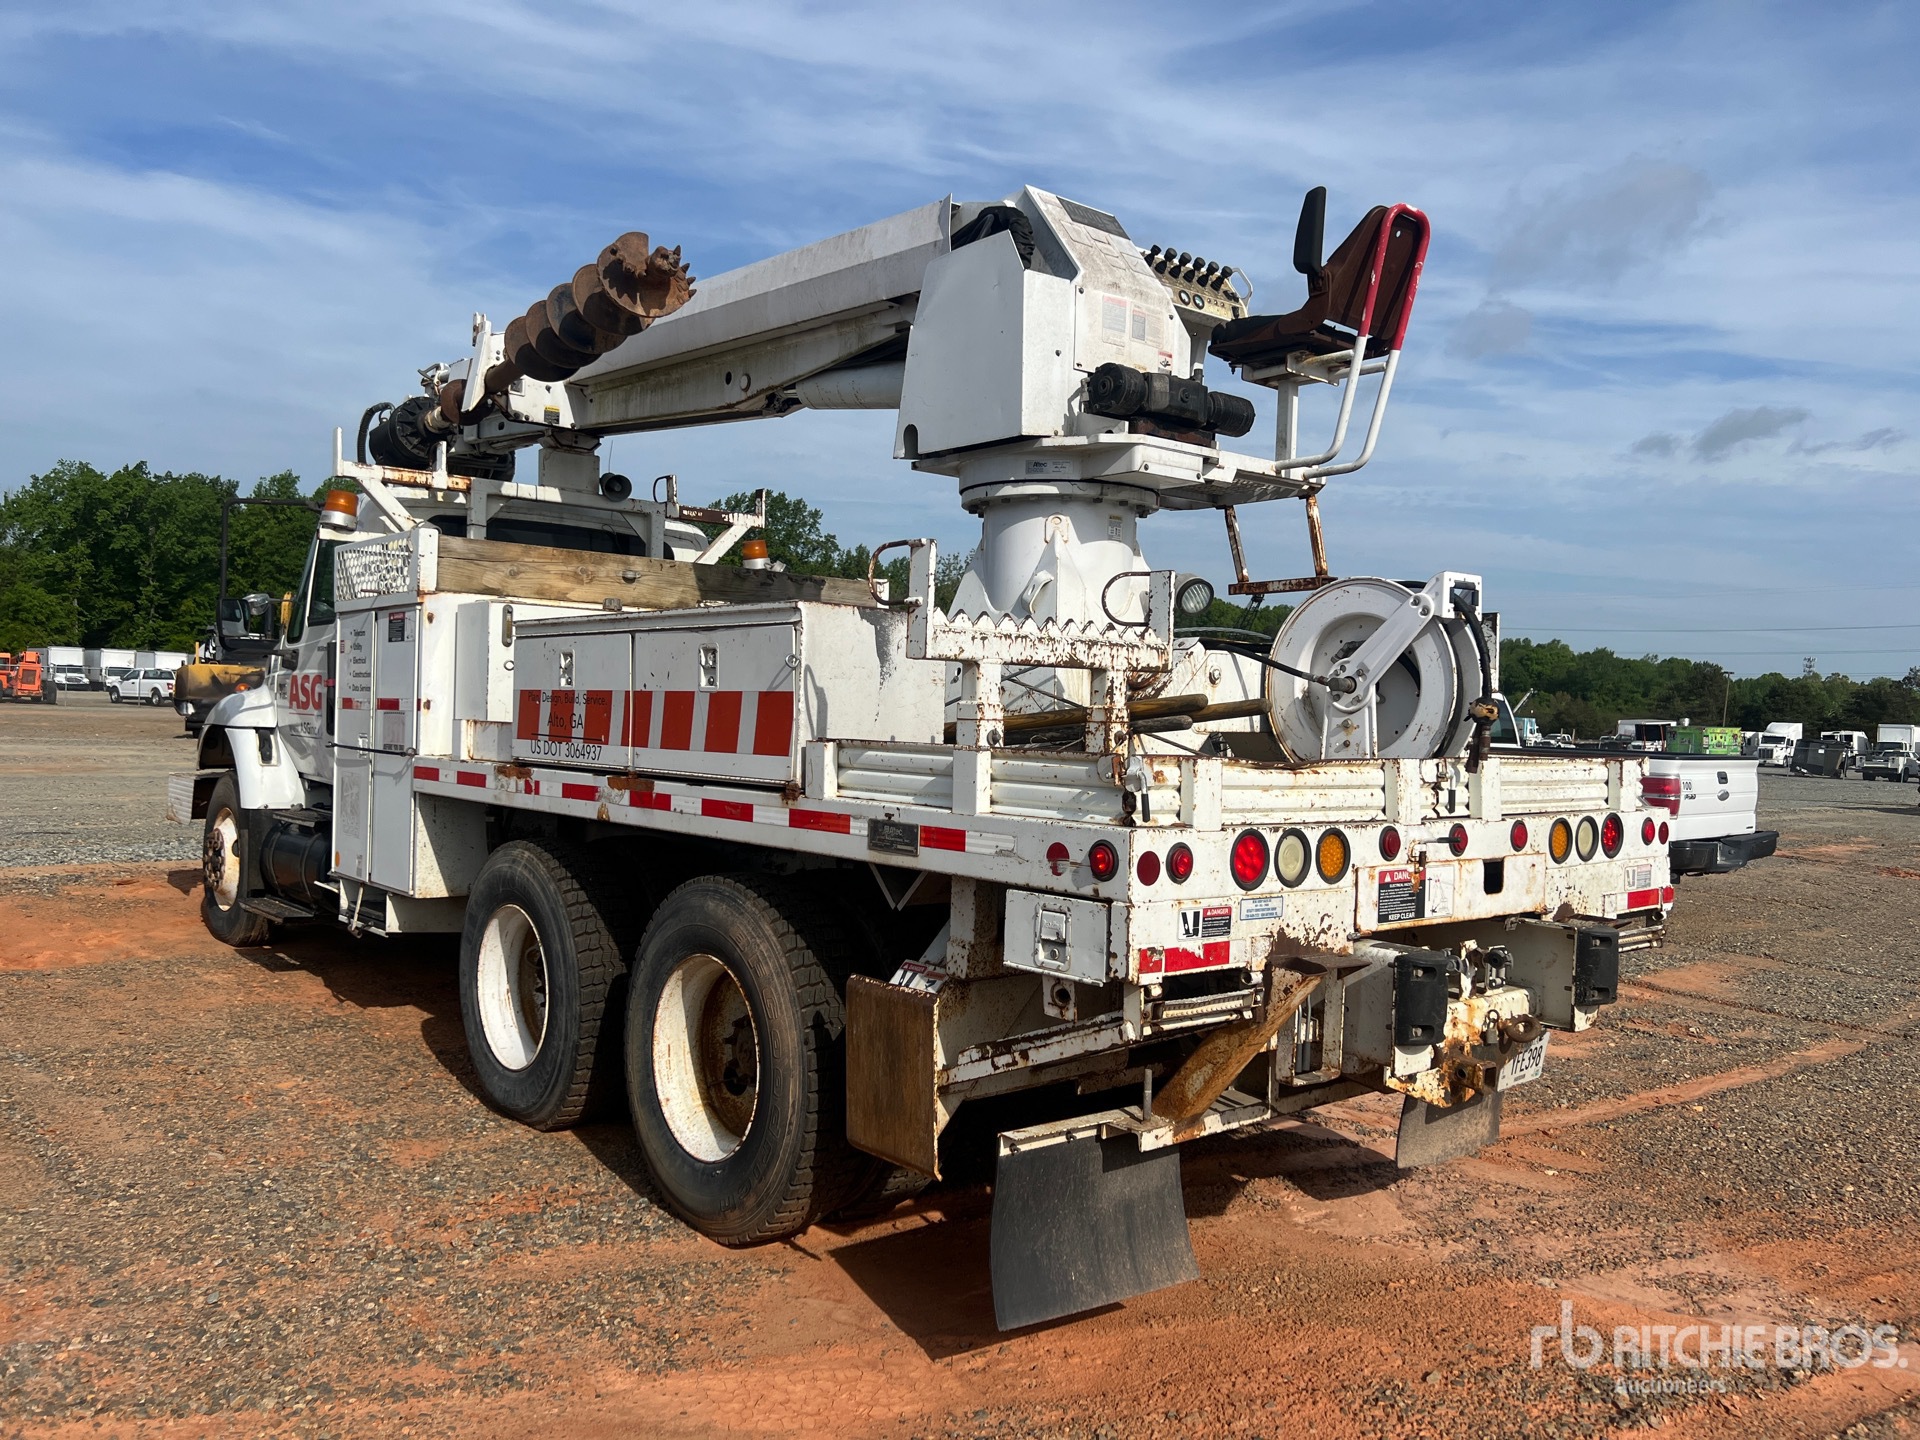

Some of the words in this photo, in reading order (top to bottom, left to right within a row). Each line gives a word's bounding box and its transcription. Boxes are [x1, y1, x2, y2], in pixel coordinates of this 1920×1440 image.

[288, 674, 323, 711] ASG
[547, 712, 567, 731] Alto,
[569, 712, 584, 730] GA
[530, 739, 541, 755] US
[543, 740, 563, 757] DOT
[564, 742, 603, 761] 3064937
[1210, 908, 1229, 916] DANGER
[1388, 913, 1400, 921] KEEP
[1400, 912, 1416, 920] CLEAR
